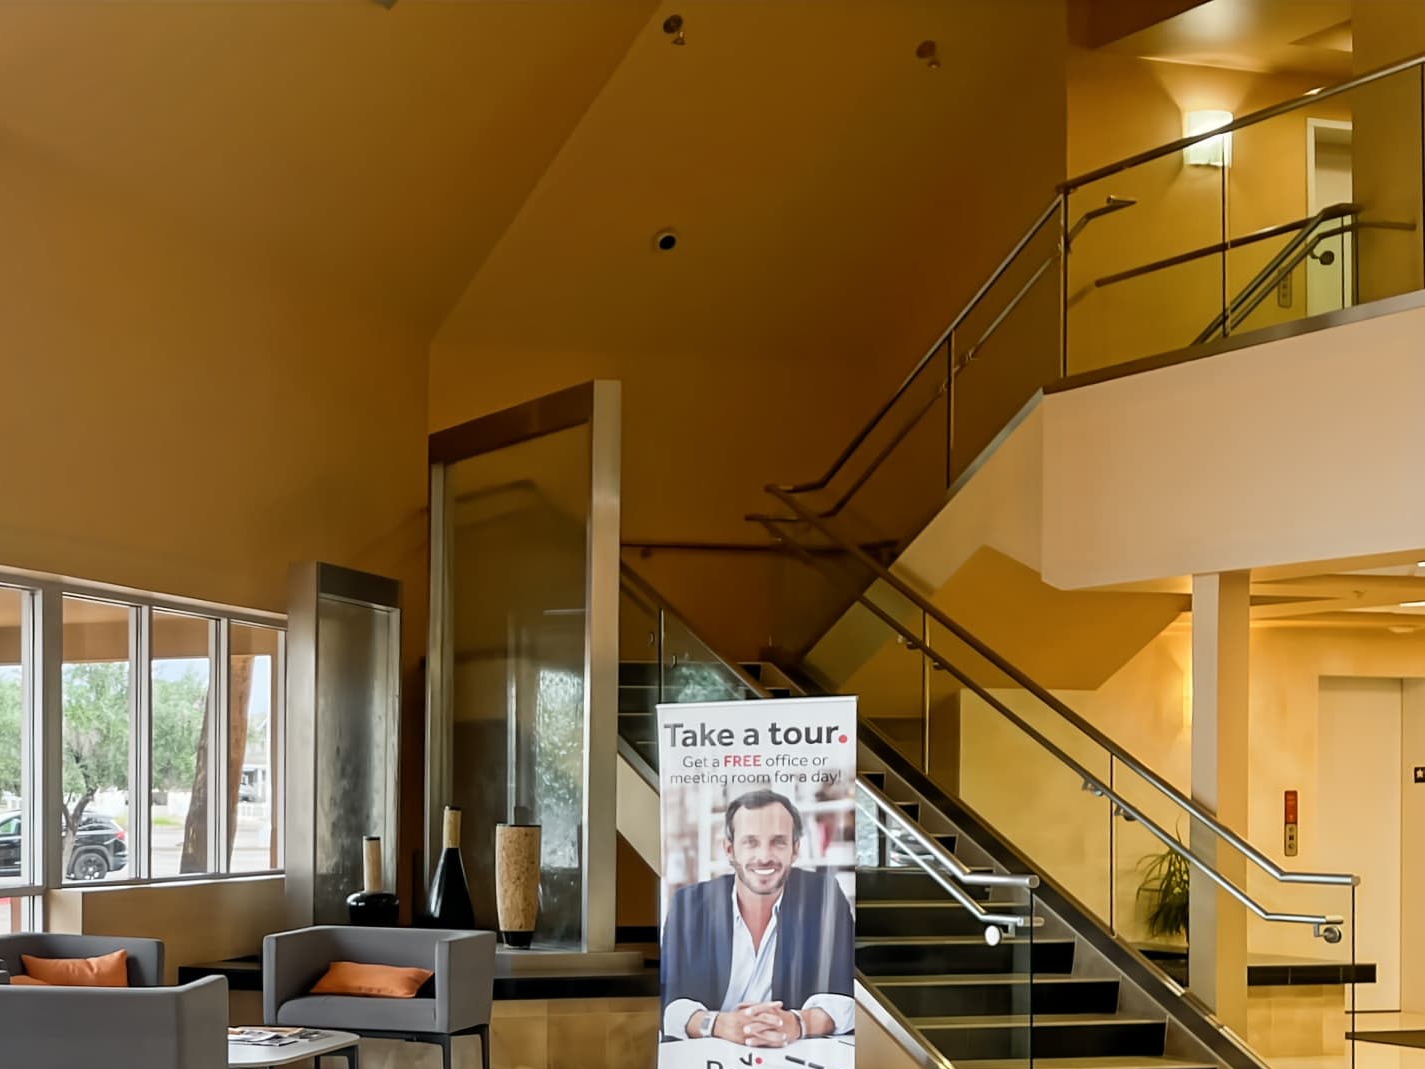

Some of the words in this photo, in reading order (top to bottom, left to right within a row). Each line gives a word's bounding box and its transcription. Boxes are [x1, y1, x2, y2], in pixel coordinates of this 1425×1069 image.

[663, 722, 735, 747] Take
[742, 727, 760, 746] a
[768, 722, 848, 745] tour.
[682, 755, 709, 768] Get
[711, 758, 720, 768] a
[723, 754, 762, 768] FREE
[765, 754, 808, 767] office
[812, 756, 829, 767] or
[670, 771, 728, 787] meeting
[731, 773, 771, 784] room
[774, 771, 796, 784] for
[798, 773, 807, 784] a
[810, 770, 842, 787] day!
